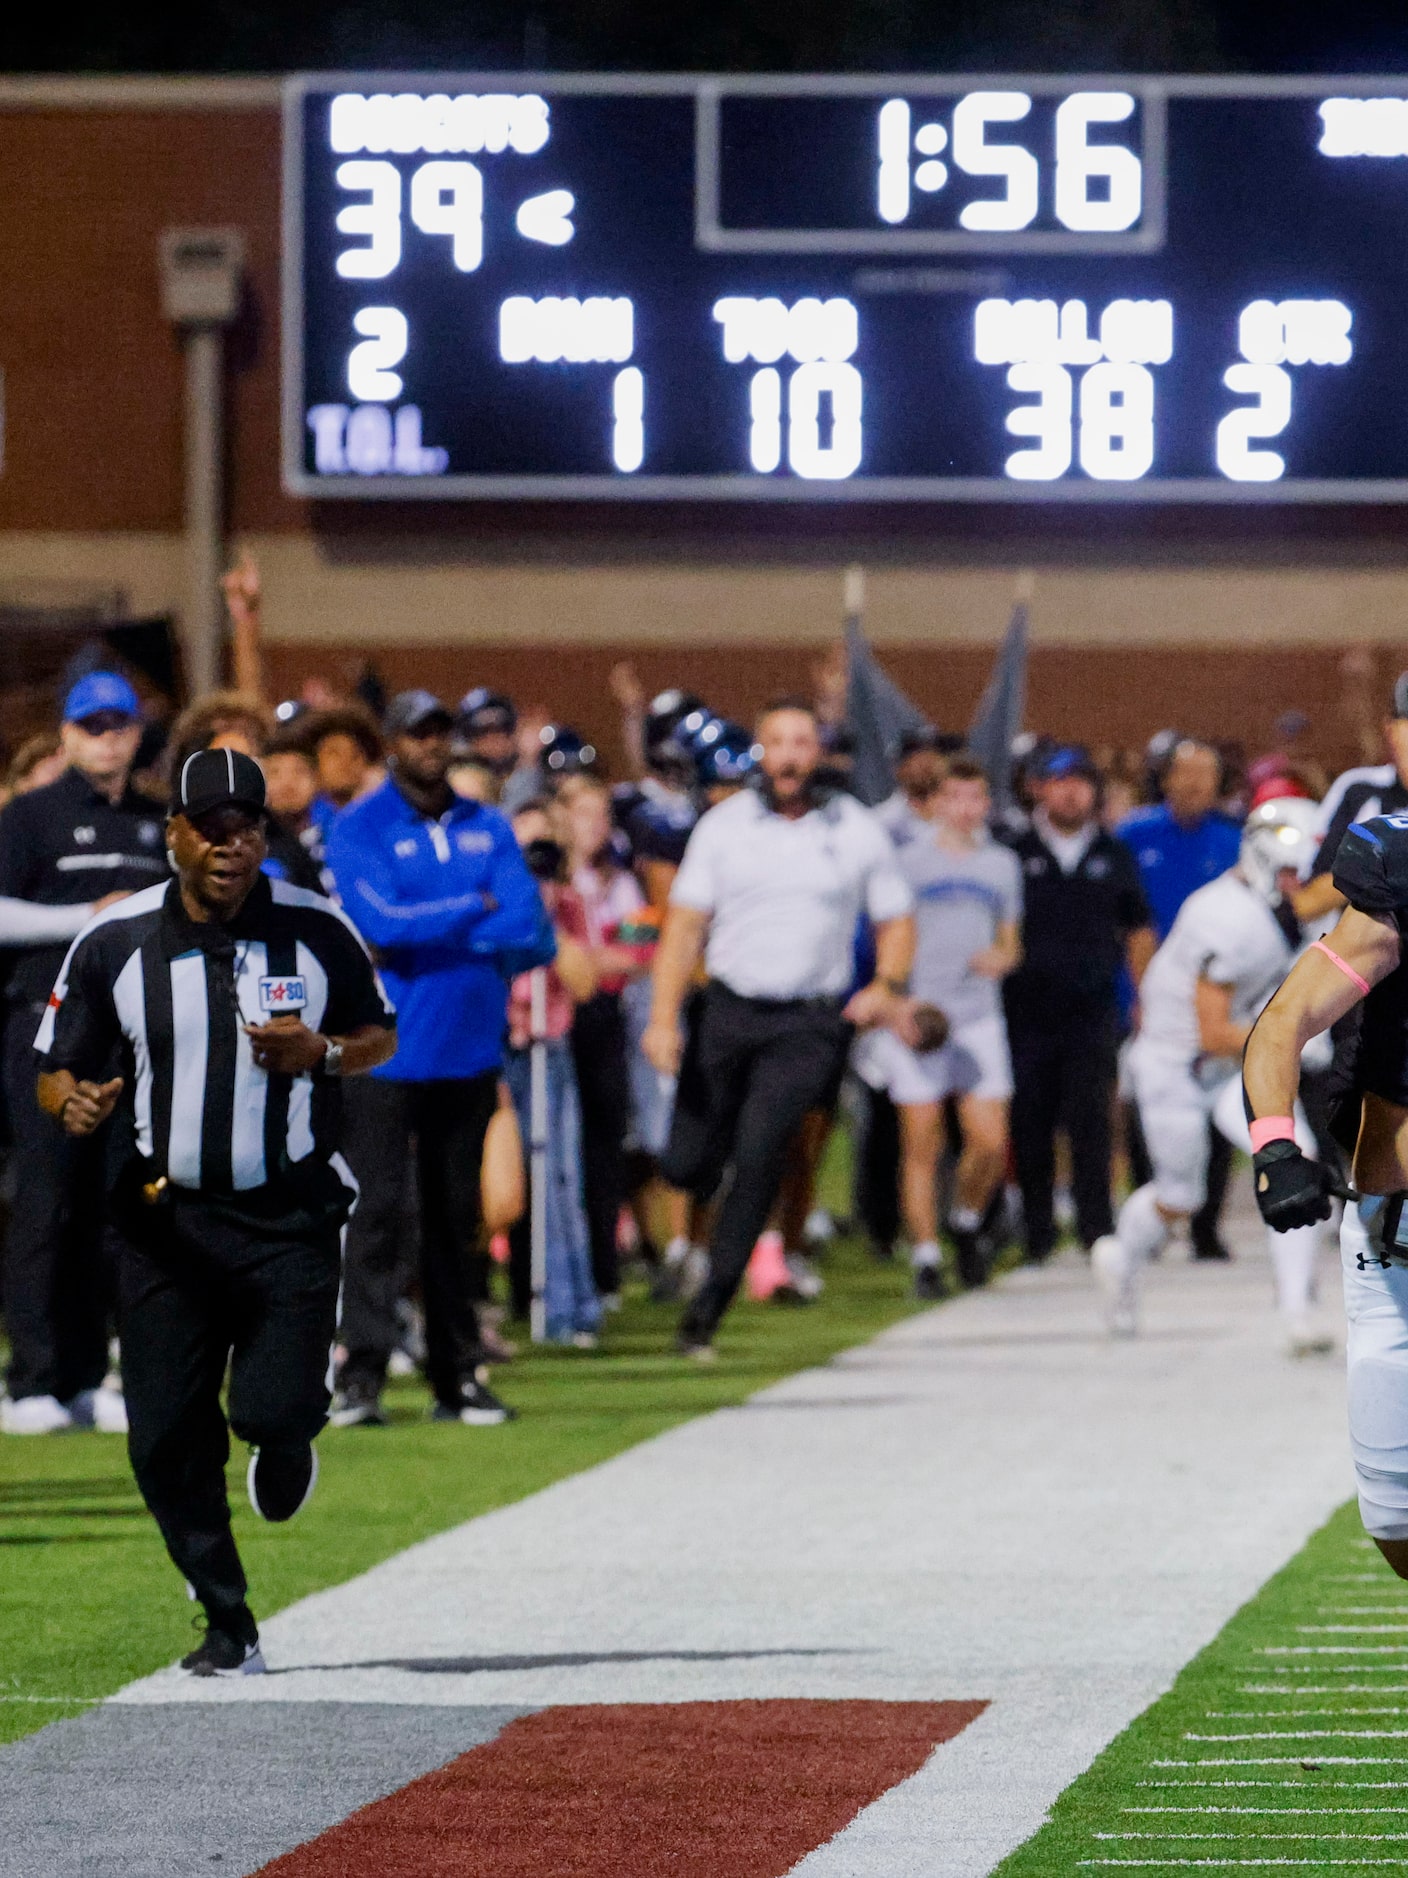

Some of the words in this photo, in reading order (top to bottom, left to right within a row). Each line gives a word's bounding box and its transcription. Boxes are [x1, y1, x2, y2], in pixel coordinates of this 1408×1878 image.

[335, 160, 484, 279] 39
[877, 92, 1142, 232] 1:56
[347, 306, 409, 401] 2
[612, 366, 644, 473] 1
[750, 361, 862, 480] 10
[1004, 362, 1155, 481] 38
[1216, 363, 1293, 482] 2
